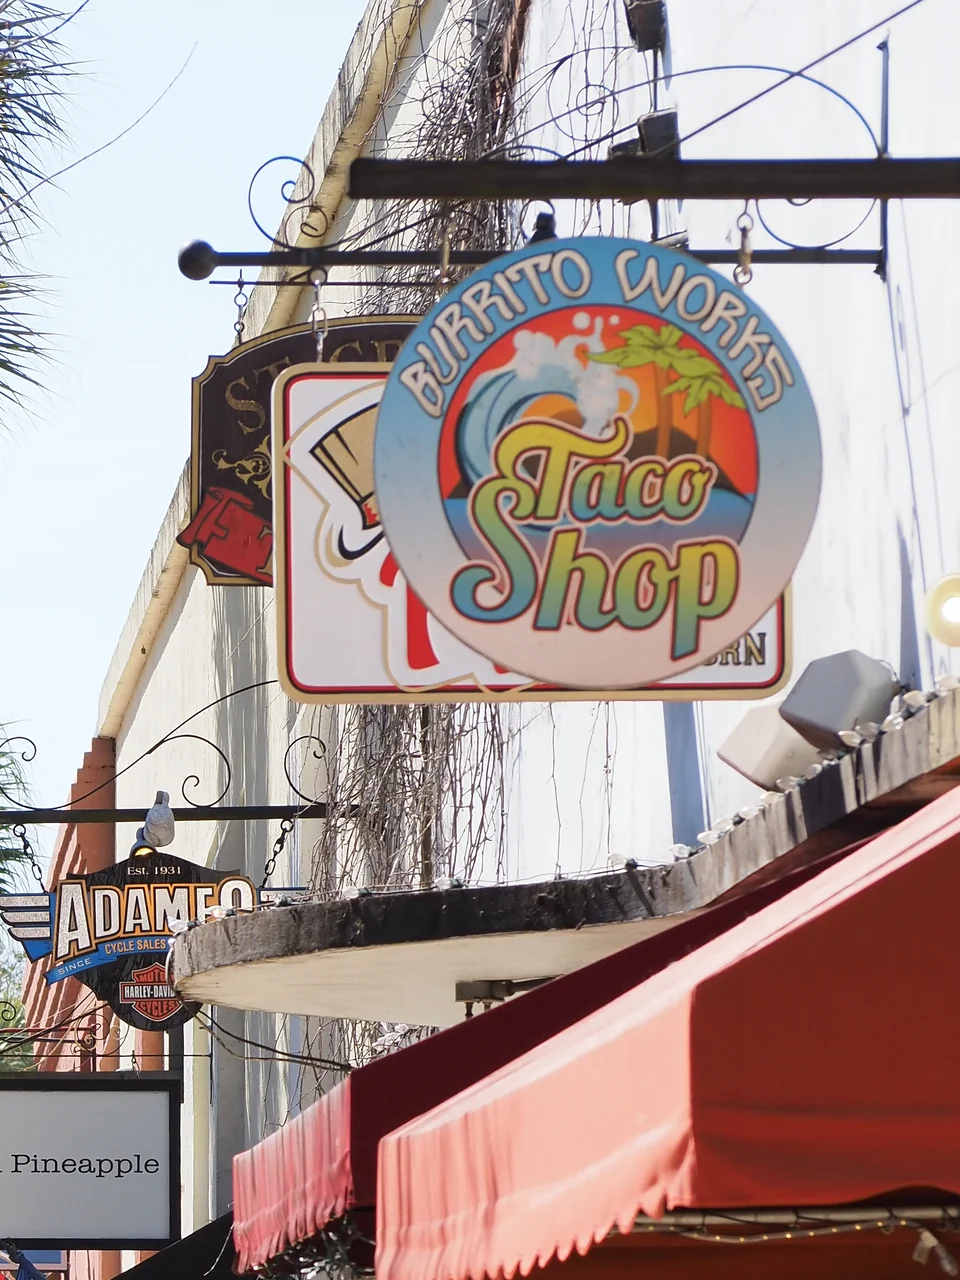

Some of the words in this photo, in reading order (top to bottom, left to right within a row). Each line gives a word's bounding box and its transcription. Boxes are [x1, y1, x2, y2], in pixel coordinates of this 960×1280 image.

[400, 247, 592, 418] BURRITO
[614, 248, 795, 412] WORKS
[493, 416, 717, 523] Taco
[449, 476, 742, 661] Shop
[127, 866, 149, 876] Est.
[154, 866, 181, 876] 1931
[104, 942, 135, 955] CYCLE
[136, 938, 166, 951] SALES
[57, 957, 92, 976] SINCE
[140, 968, 170, 983] MOTO
[124, 985, 176, 999] HARLEY-DAVID
[141, 1001, 175, 1016] CYCLES
[10, 1154, 160, 1178] Pineapple
